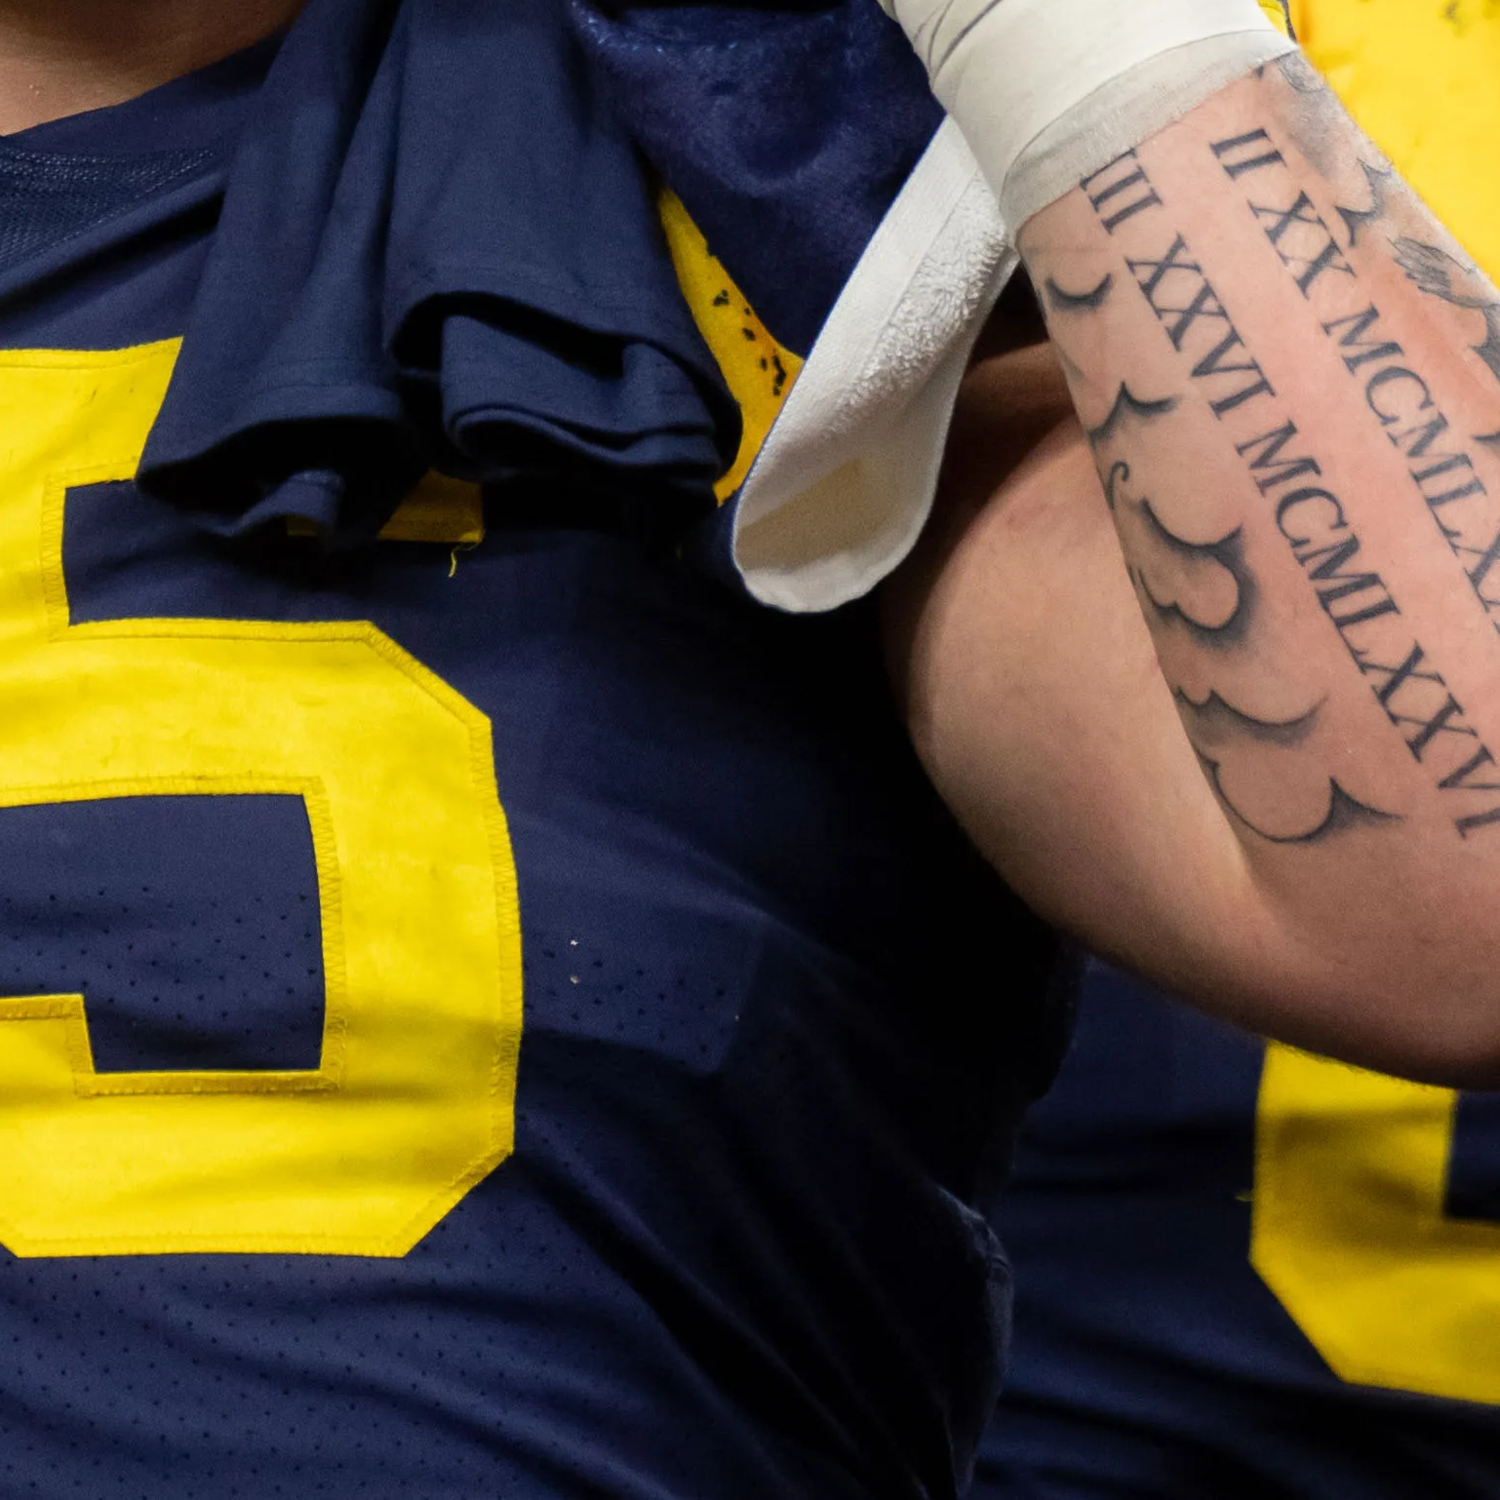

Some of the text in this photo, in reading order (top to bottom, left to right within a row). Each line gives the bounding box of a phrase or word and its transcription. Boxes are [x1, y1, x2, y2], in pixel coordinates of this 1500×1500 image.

[1124, 231, 1277, 420] XXVI
[1209, 127, 1500, 637] II XX MCMLX
